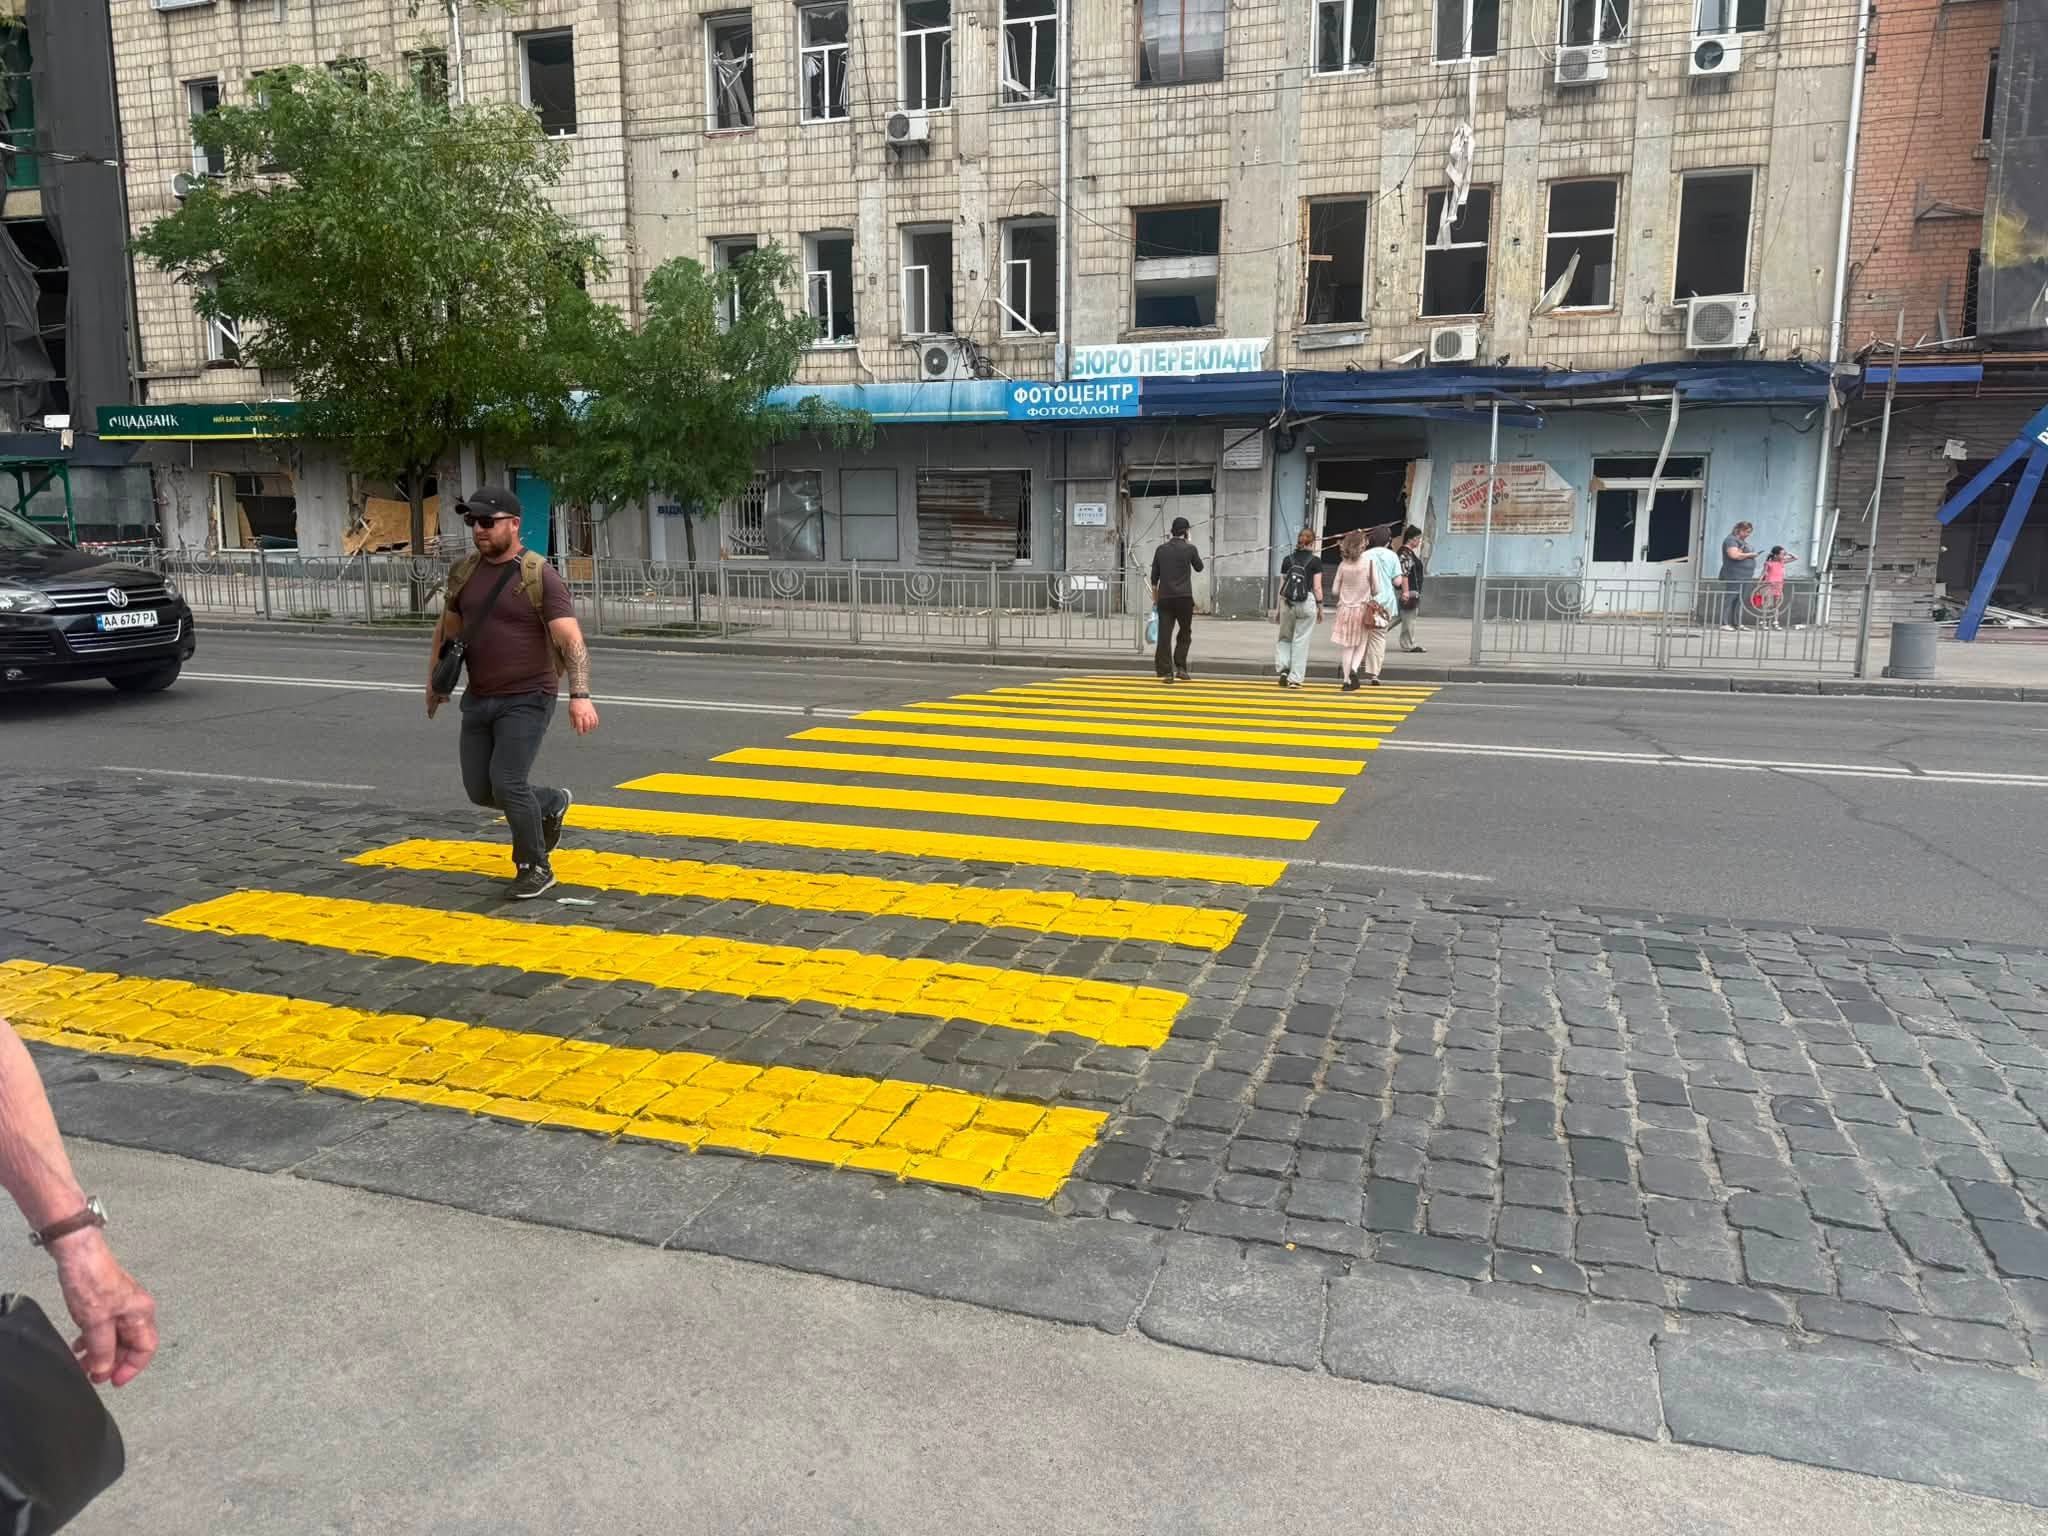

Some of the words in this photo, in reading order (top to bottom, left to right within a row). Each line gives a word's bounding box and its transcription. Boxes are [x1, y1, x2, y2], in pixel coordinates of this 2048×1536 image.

[1072, 350, 1132, 375] БЮРО
[1013, 383, 1134, 405] ФОТОЦЕНТР
[1027, 404, 1120, 417] ФОТОСАЛОН
[104, 615, 118, 627] AA
[120, 613, 141, 625] 6767
[143, 612, 156, 624] PA
